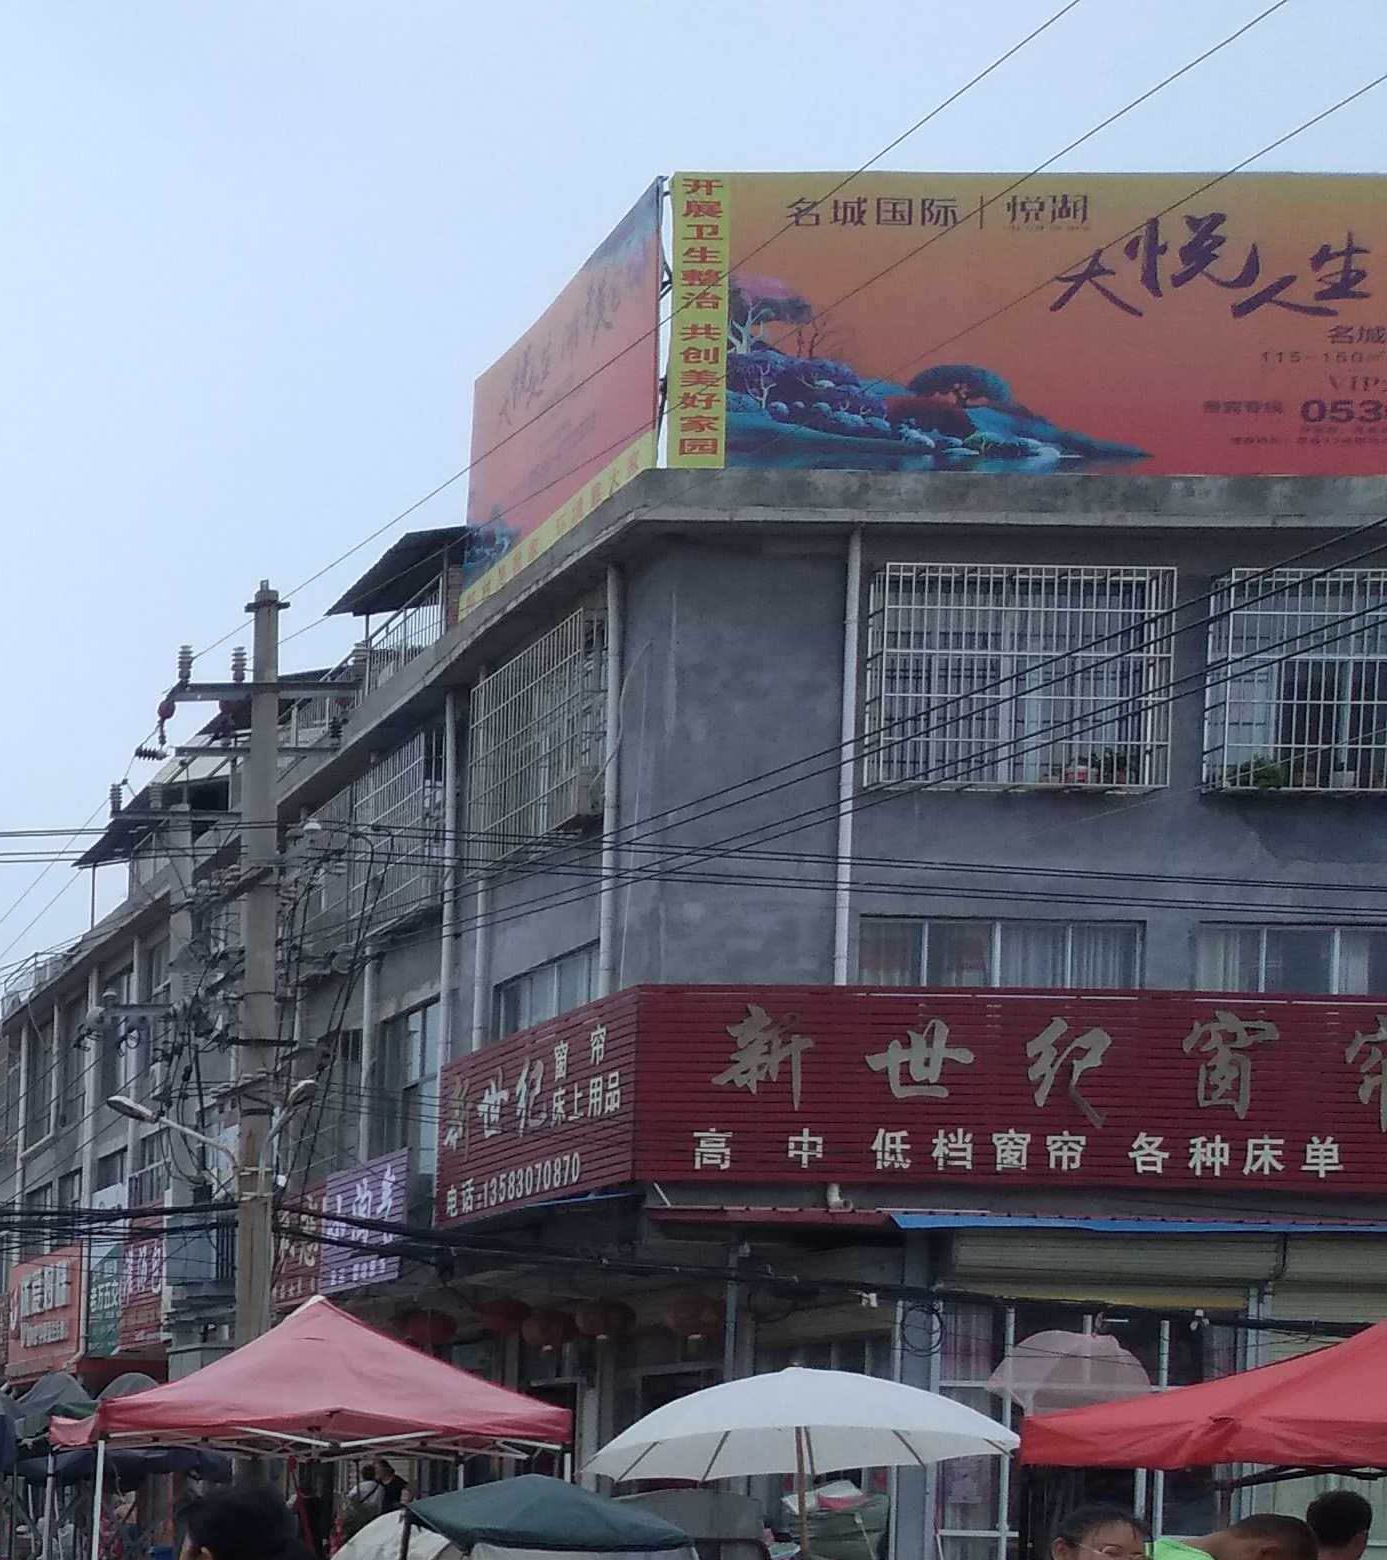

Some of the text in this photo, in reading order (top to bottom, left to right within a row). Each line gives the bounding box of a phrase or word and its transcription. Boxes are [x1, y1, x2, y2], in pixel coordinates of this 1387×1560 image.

[786, 193, 1090, 228] 名城国际 悦湖
[678, 180, 723, 456] 开展卫生整治 共创美好家园
[1300, 399, 1387, 423] 053
[553, 1024, 607, 1082] 窗帘
[442, 1054, 548, 1163] 新世纪
[550, 1070, 621, 1131] 床上用品
[1127, 1132, 1344, 1178] 各种床单
